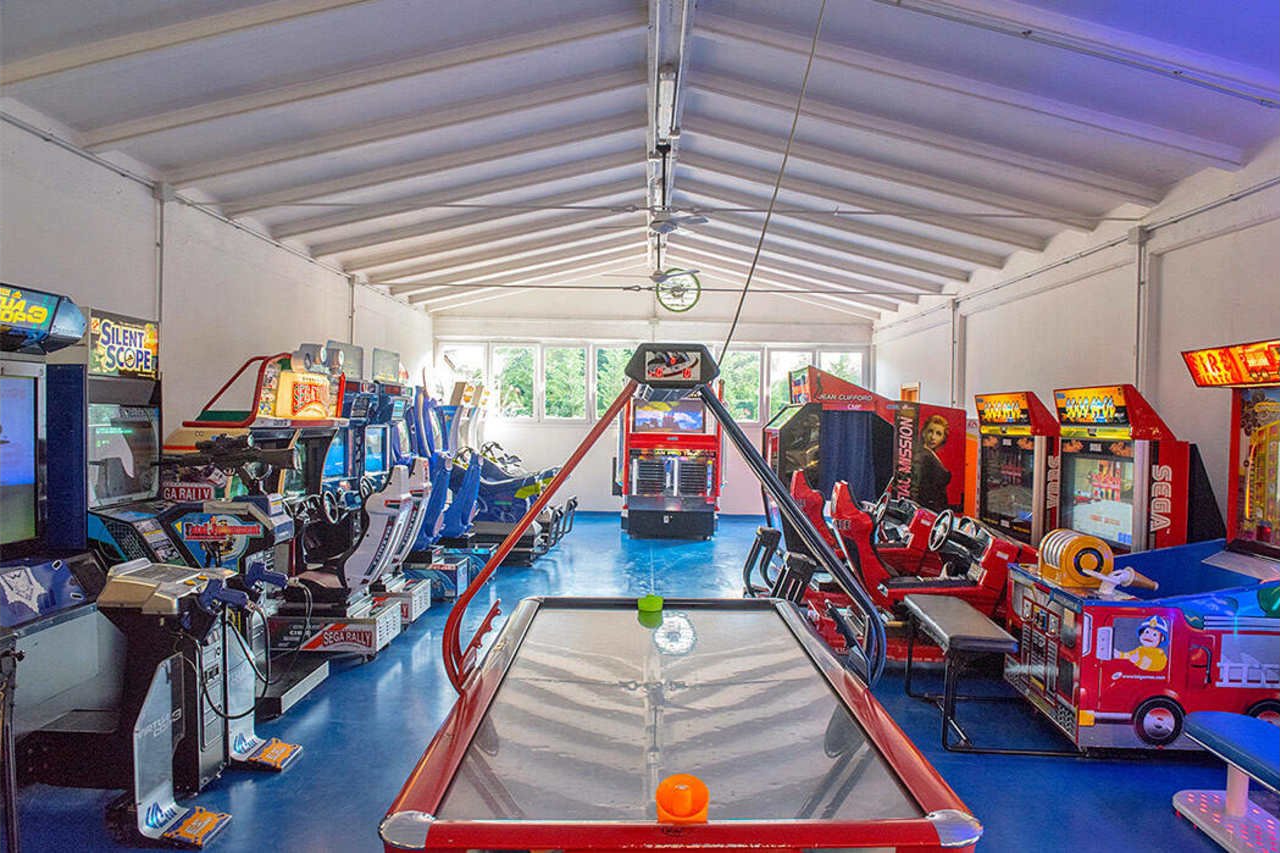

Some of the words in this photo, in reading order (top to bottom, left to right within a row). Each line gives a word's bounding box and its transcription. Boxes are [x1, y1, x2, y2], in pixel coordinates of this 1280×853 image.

[28, 305, 48, 324] 3
[100, 321, 145, 349] SILENT
[105, 345, 153, 371] SCOPE
[898, 416, 913, 473] MISSION
[163, 487, 177, 500] GA
[1150, 464, 1173, 533] SEGA
[323, 631, 346, 647] SEGA
[346, 631, 372, 648] RALLY
